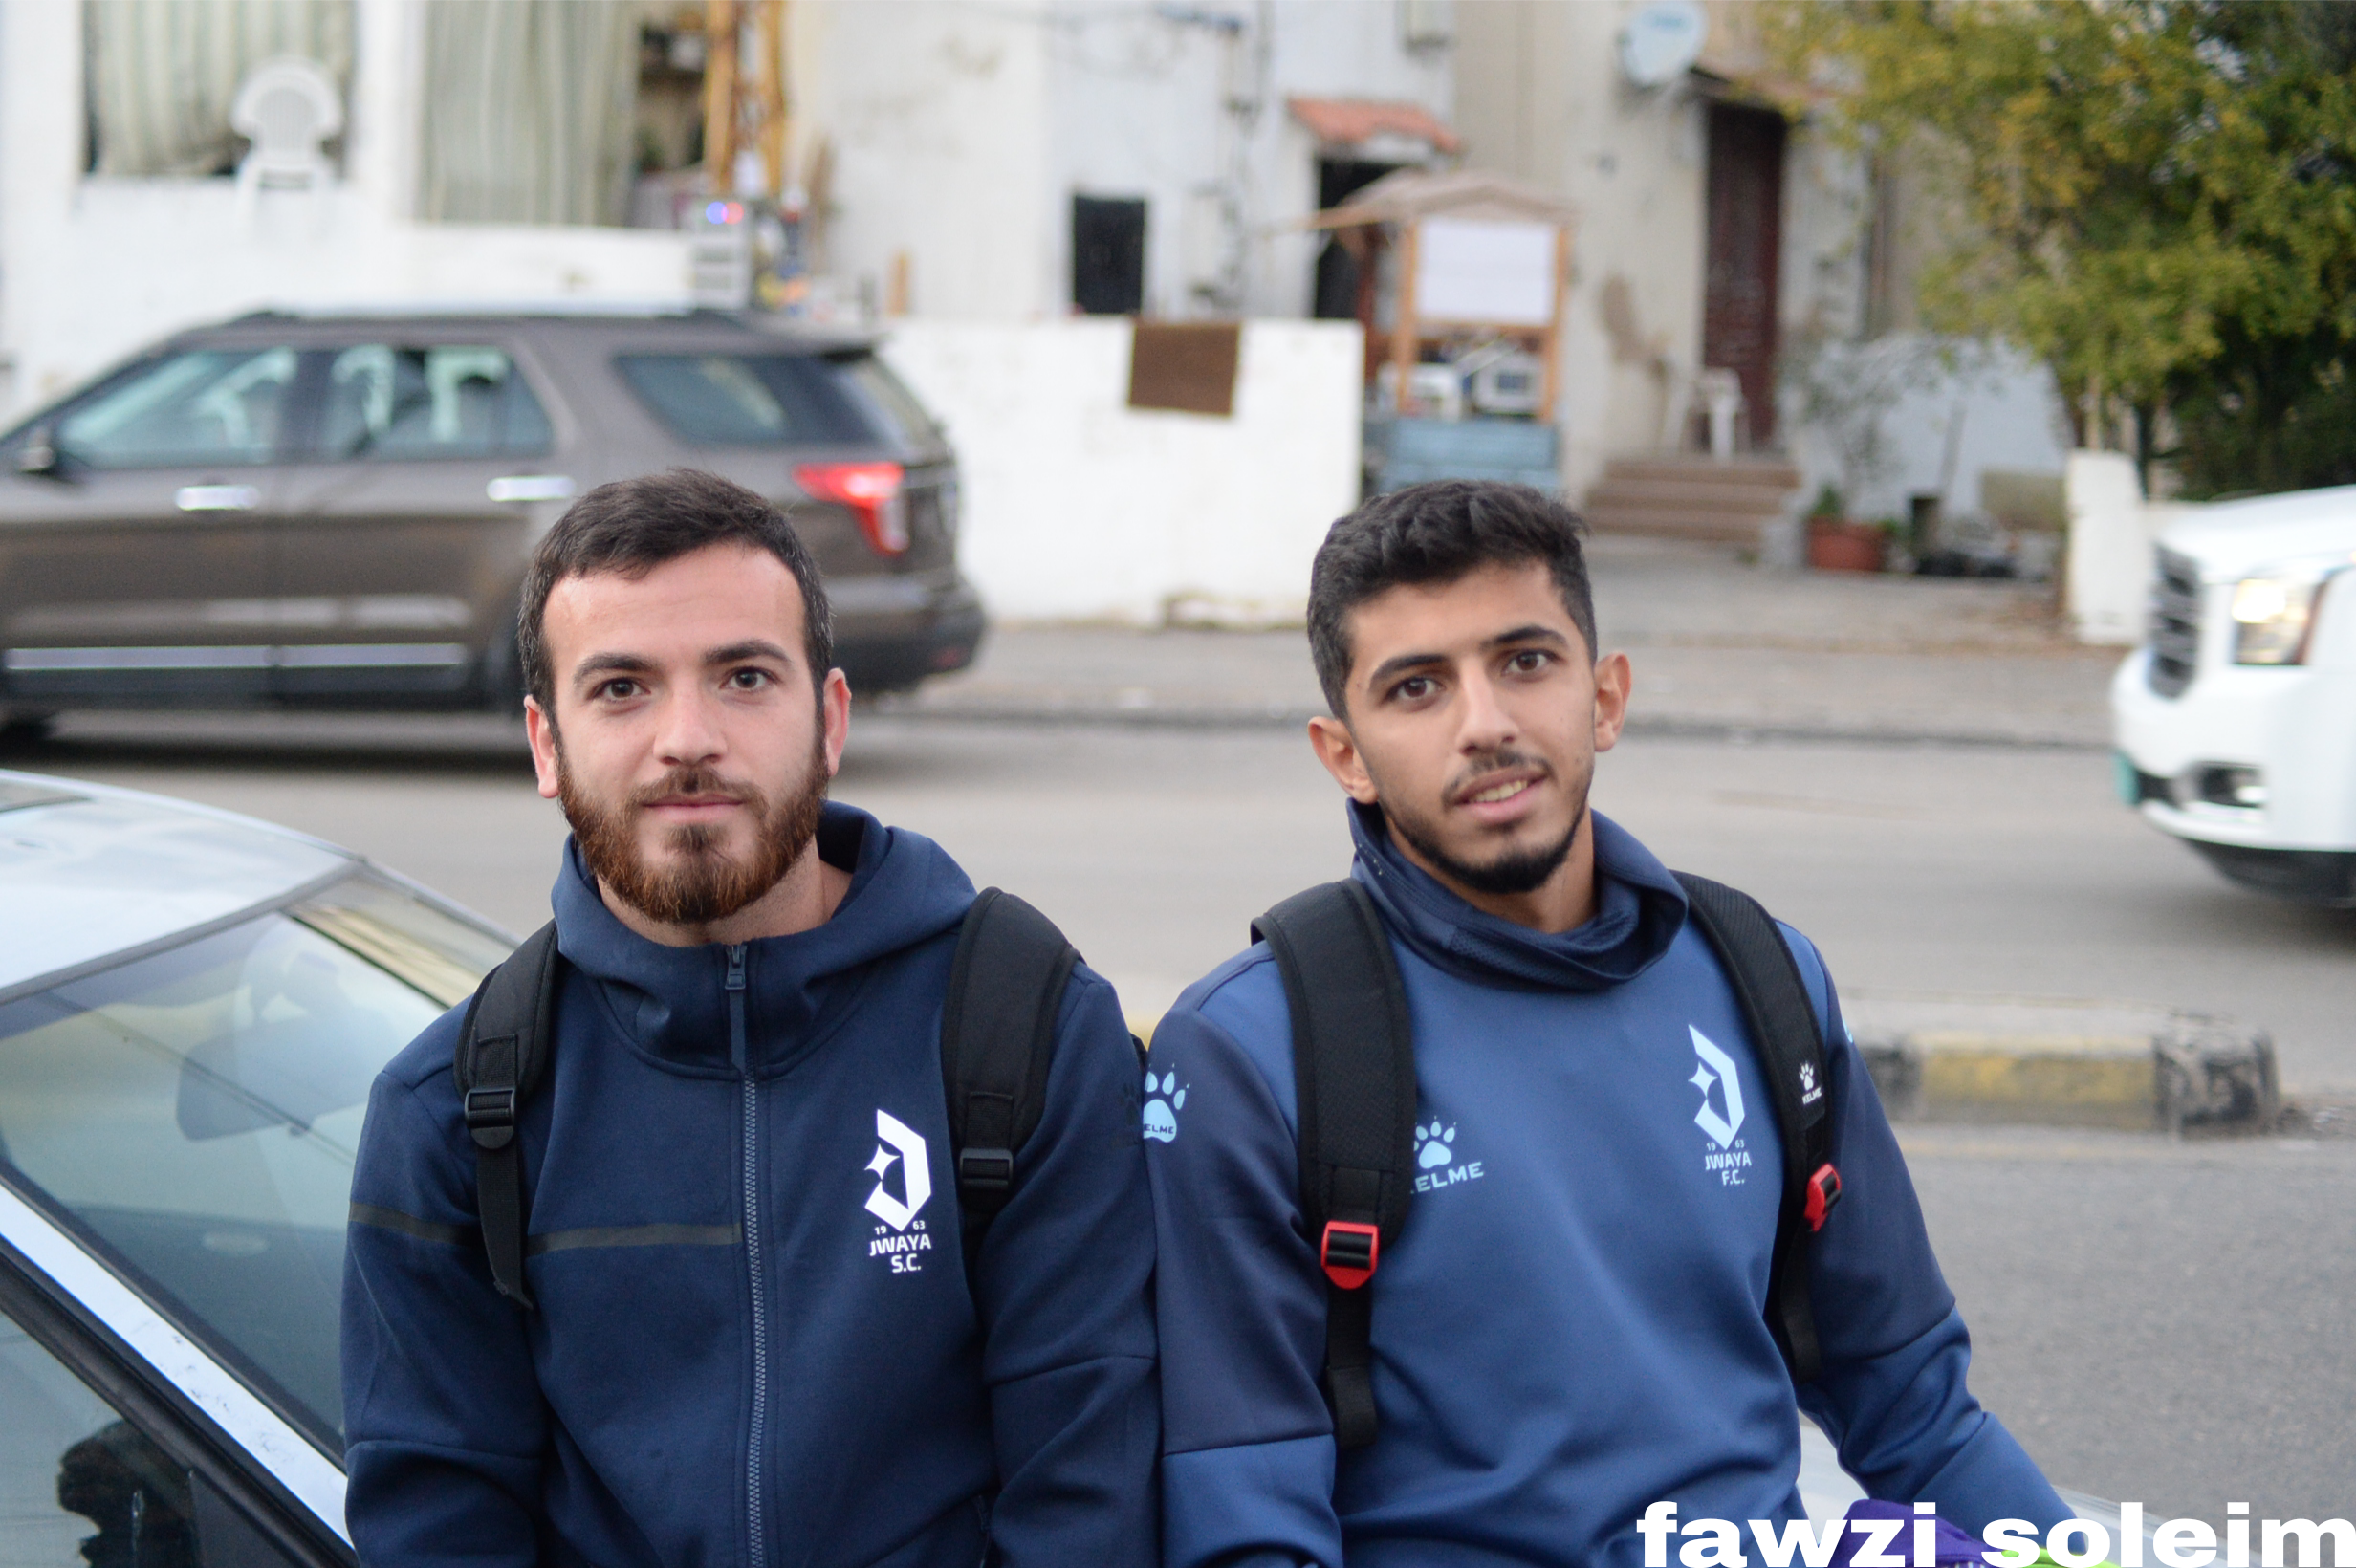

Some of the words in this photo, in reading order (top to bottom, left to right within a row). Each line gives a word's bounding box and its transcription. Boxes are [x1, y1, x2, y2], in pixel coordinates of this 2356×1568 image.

[1144, 1123, 1174, 1134] ELME
[1706, 1142, 1716, 1152] 19
[1734, 1139, 1745, 1149] 63
[1705, 1151, 1752, 1170] JWAYA
[1410, 1161, 1484, 1194] ELME
[1722, 1169, 1745, 1186] F.C.
[874, 1225, 887, 1235] 19
[912, 1220, 926, 1230] 63
[869, 1233, 931, 1256] JWAYA
[890, 1253, 921, 1273] S.C.
